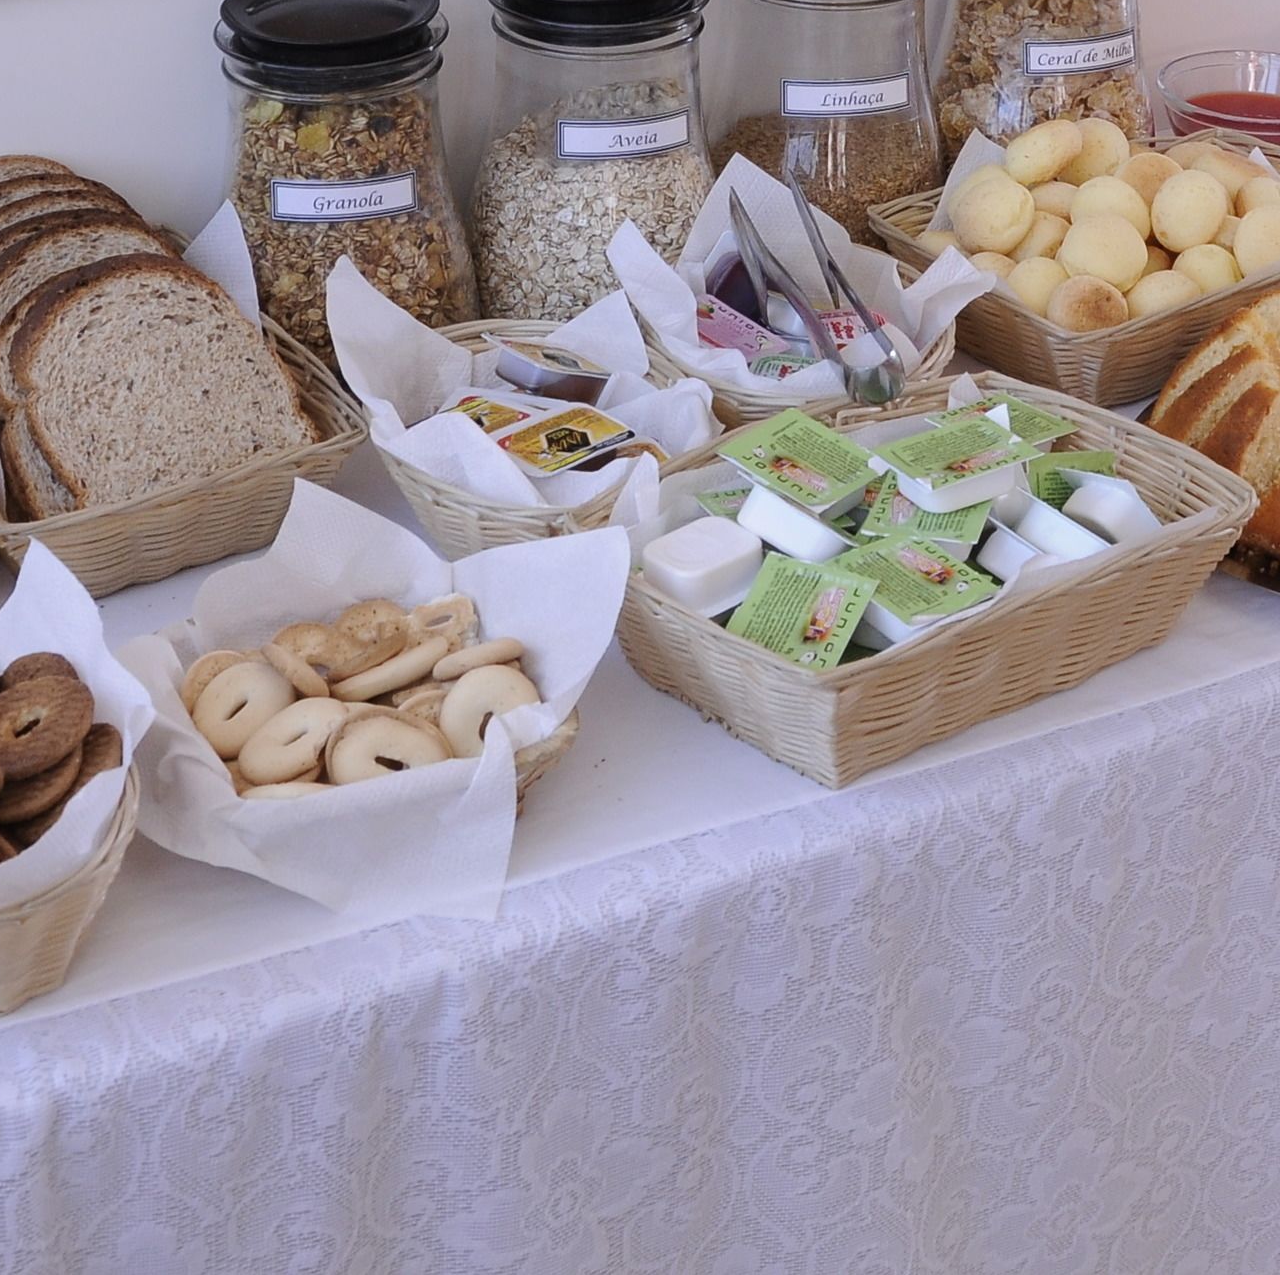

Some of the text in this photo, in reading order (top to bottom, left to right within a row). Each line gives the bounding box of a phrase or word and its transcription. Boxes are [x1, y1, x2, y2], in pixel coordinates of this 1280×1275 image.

[1037, 50, 1081, 66] Ceral
[1082, 48, 1098, 63] de
[820, 91, 884, 107] Linhaça
[608, 131, 658, 149] Aveia
[313, 190, 384, 213] Granola
